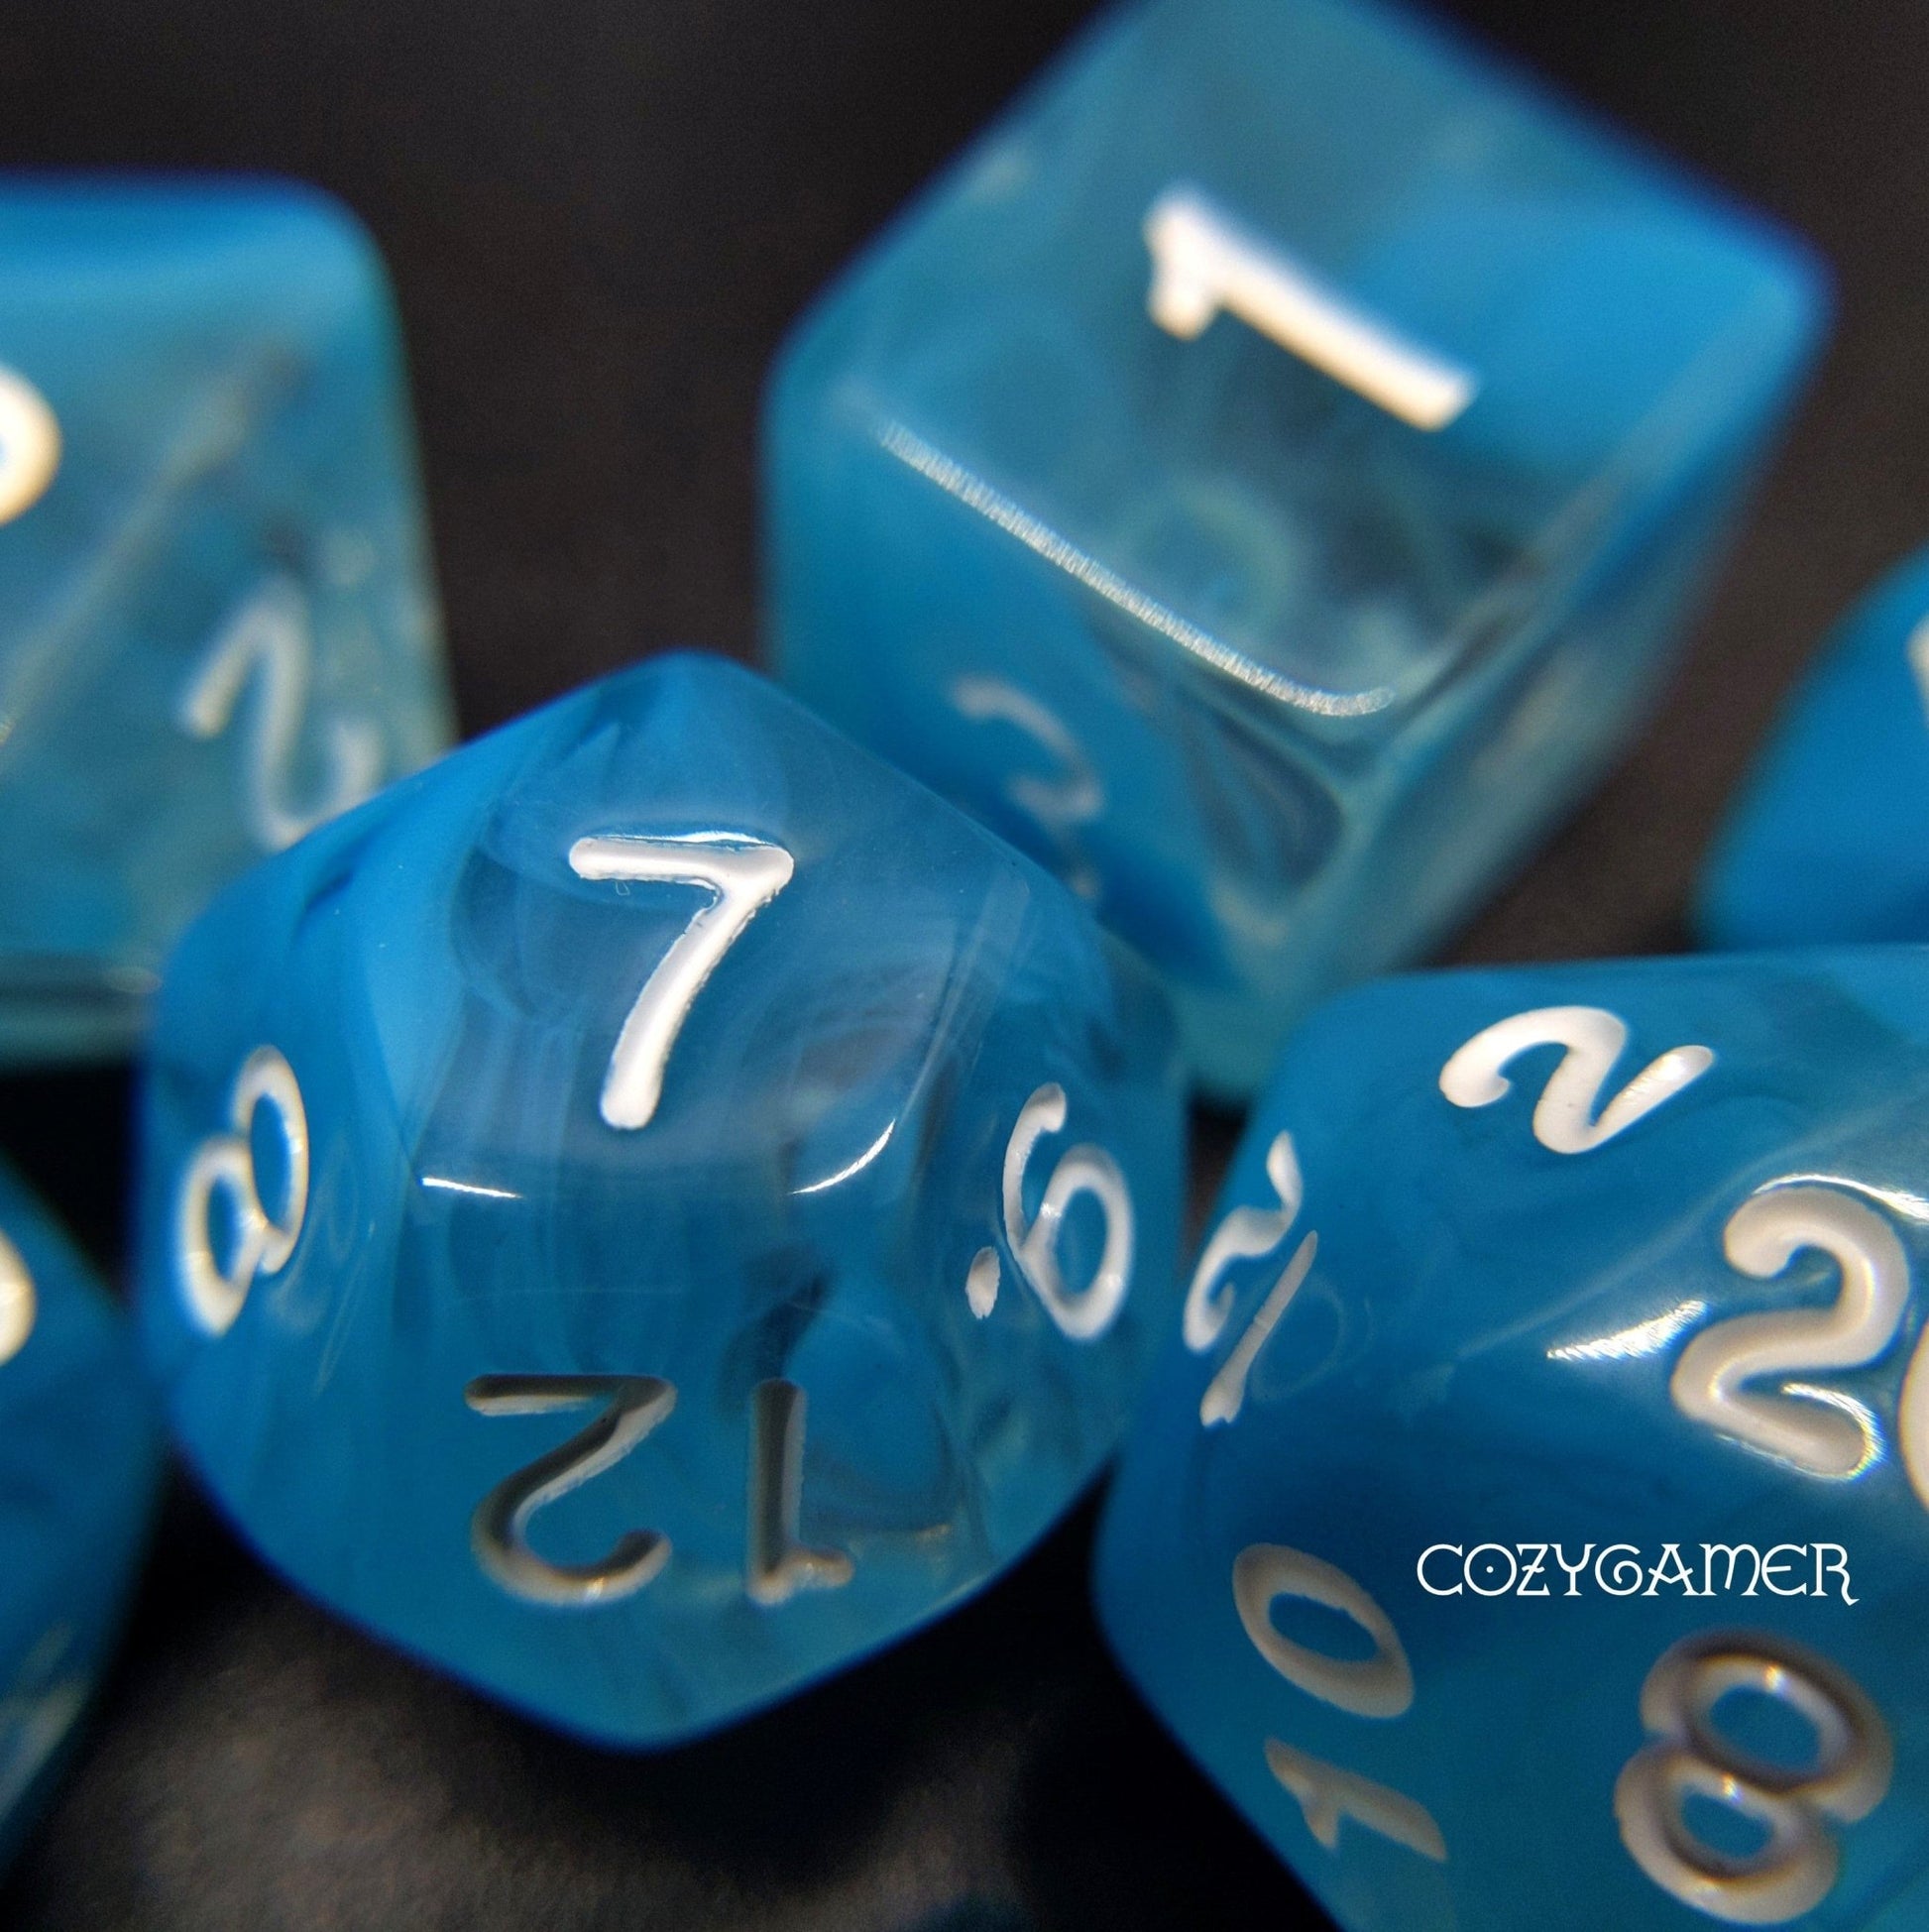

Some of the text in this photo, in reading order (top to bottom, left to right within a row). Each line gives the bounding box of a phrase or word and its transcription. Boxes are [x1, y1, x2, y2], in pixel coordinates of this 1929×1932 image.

[1144, 188, 1474, 431] 1
[569, 831, 794, 1130] 7
[1439, 1006, 1716, 1154] 2
[180, 1044, 309, 1338] 8
[465, 1373, 854, 1606] 12
[1670, 1182, 1929, 1514] 2
[1232, 1542, 1447, 1862] 10
[1614, 1630, 1894, 1924] 8
